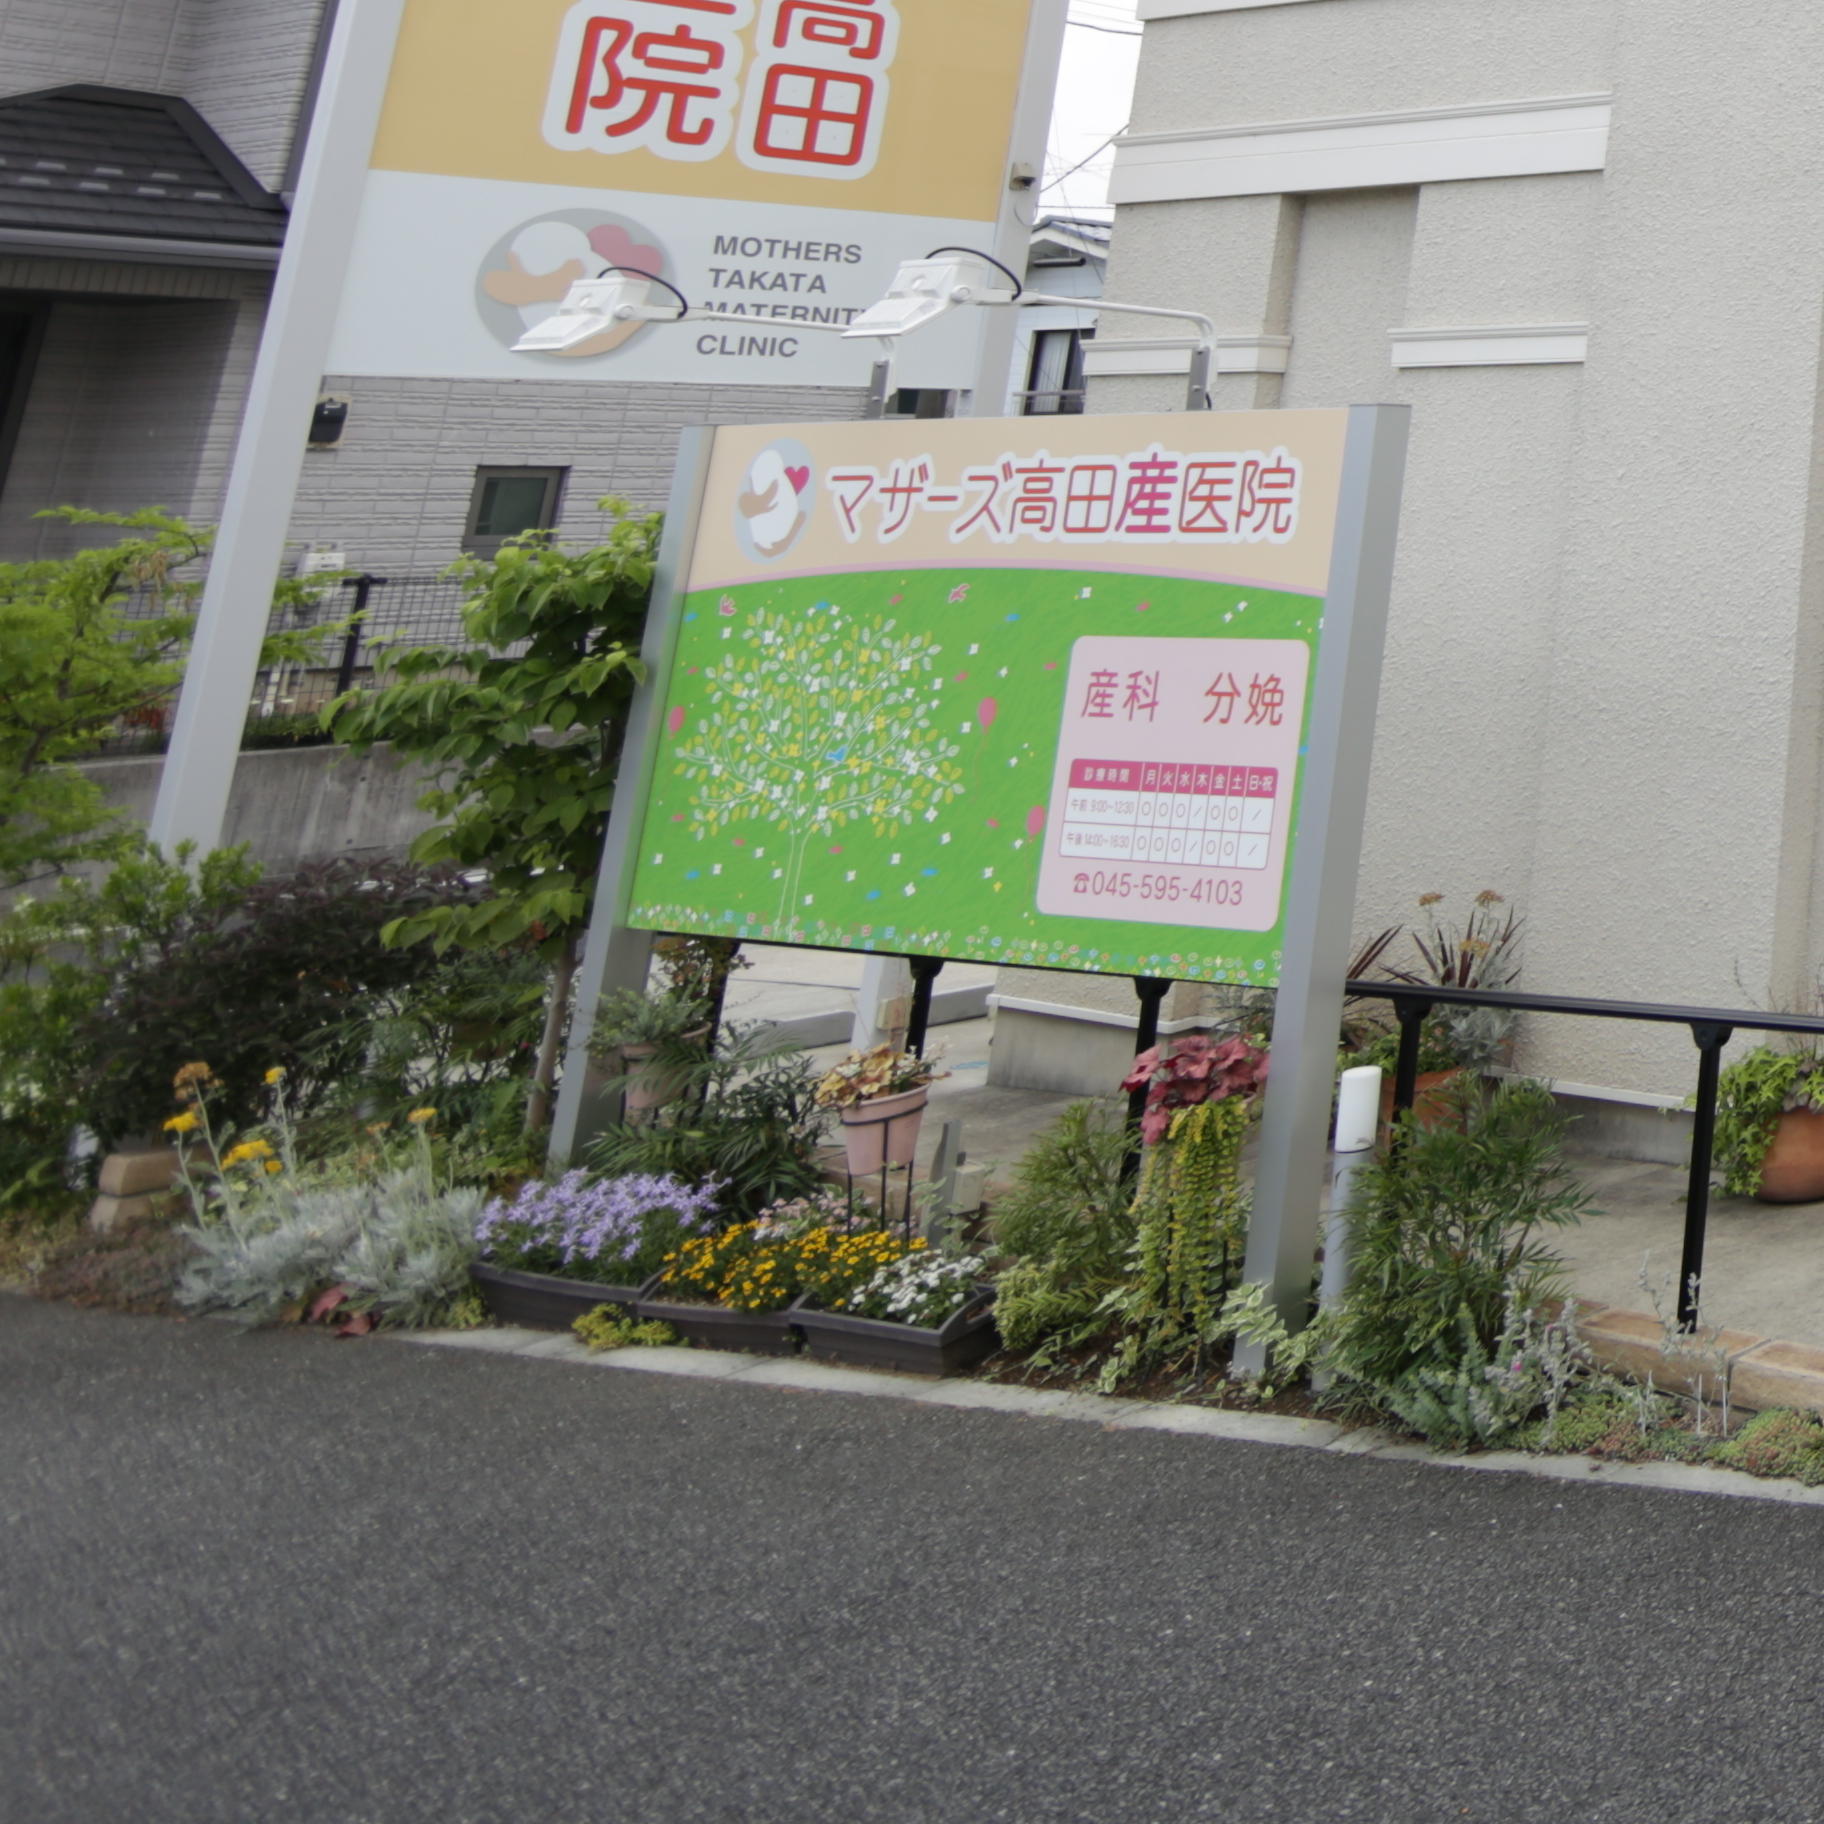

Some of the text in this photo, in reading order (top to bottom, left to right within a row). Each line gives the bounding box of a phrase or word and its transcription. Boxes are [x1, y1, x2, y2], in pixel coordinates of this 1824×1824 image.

[712, 234, 863, 264] MOTHERS
[707, 267, 827, 294] TAKATA
[703, 301, 868, 326] MATERNIT
[695, 334, 800, 358] CLINIC
[830, 452, 1296, 535] マザーズ高田産医院
[1081, 668, 1285, 727] 産科 分娩
[1145, 769, 1156, 785] 月
[1162, 770, 1173, 786] 火
[1179, 771, 1191, 787] 水
[1196, 772, 1208, 788] 木
[1213, 773, 1225, 789] 金
[1231, 774, 1243, 790] 土
[1091, 870, 1244, 906] 045-595-4103
